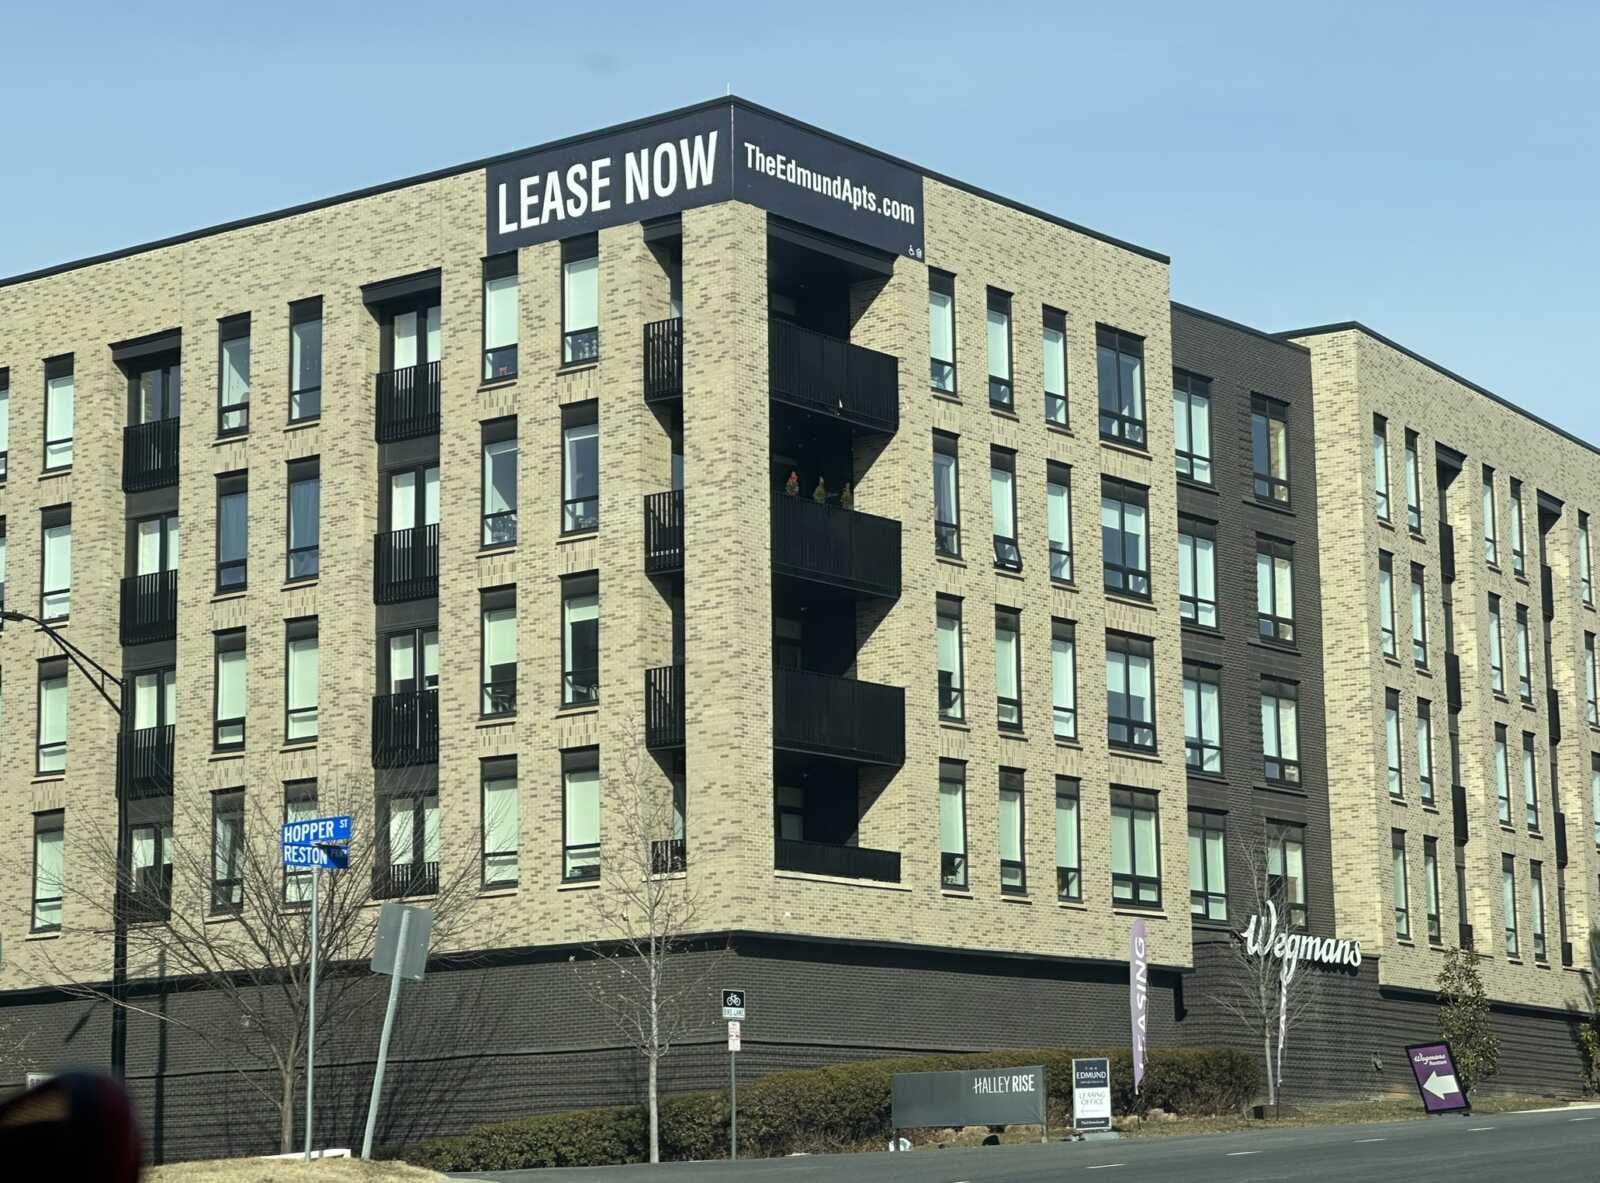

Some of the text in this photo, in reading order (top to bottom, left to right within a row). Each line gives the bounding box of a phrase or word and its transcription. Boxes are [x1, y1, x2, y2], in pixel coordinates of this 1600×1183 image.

[498, 130, 718, 235] LEASE NOW
[744, 141, 915, 225] TheEdmundApts.com
[284, 818, 348, 843] HOPPER ST
[284, 845, 328, 865] RESTON
[1241, 900, 1362, 985] Wegmans
[1135, 936, 1147, 1070] EASING
[972, 1074, 1035, 1094] HALLEY RISE
[1076, 1071, 1107, 1080] EDMUND
